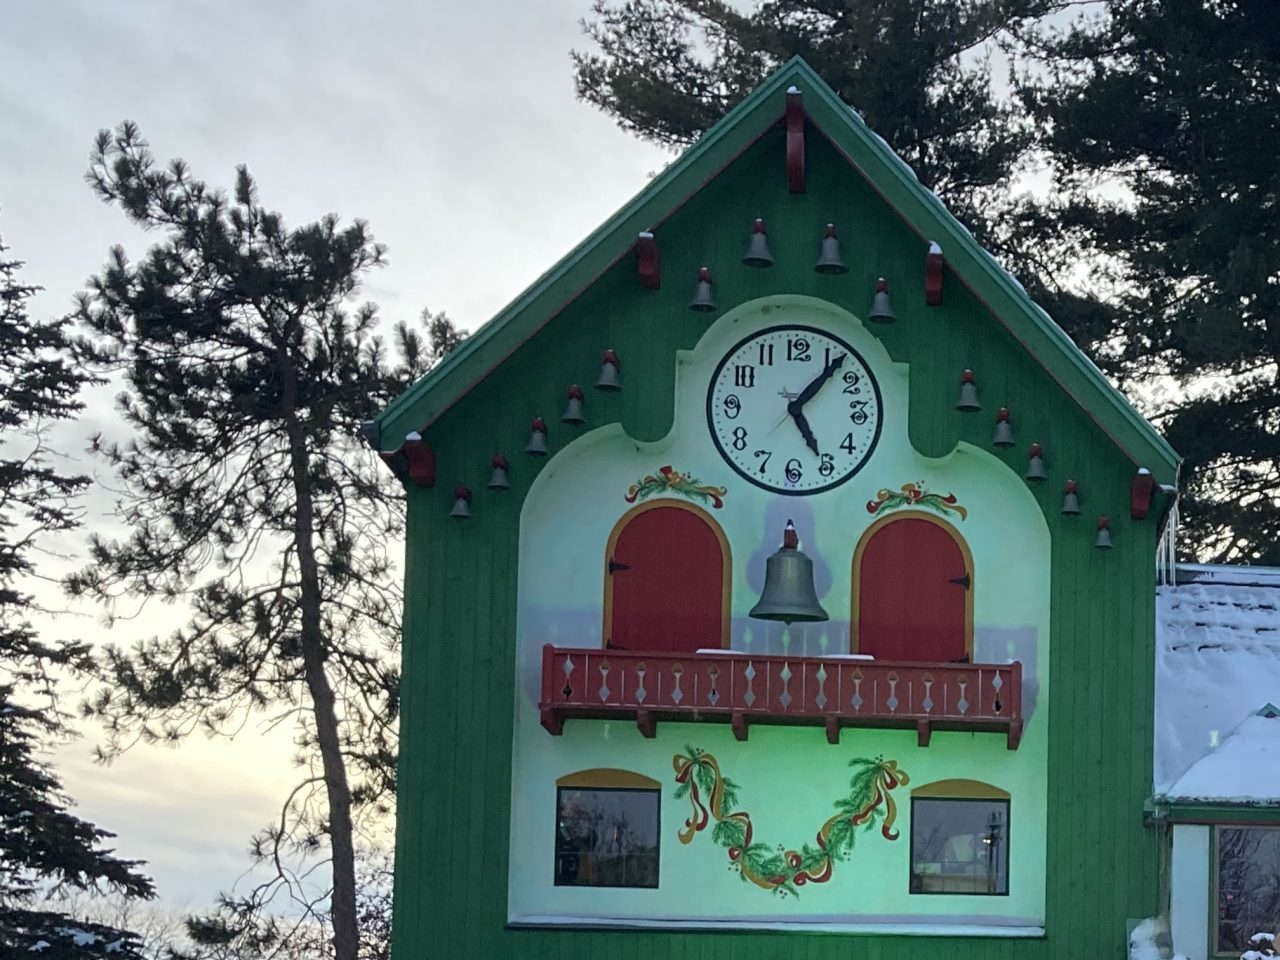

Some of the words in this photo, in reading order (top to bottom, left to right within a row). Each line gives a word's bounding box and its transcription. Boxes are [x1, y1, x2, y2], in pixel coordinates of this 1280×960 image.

[759, 344, 774, 366] 11
[787, 338, 811, 361] 12
[735, 364, 755, 388] 10
[842, 371, 861, 394] 2
[723, 394, 741, 419] 9
[850, 400, 869, 425] 3
[732, 427, 748, 450] 8
[839, 432, 856, 455] 4
[754, 450, 772, 474] 7
[785, 459, 803, 483] 6
[818, 453, 835, 477] 5
